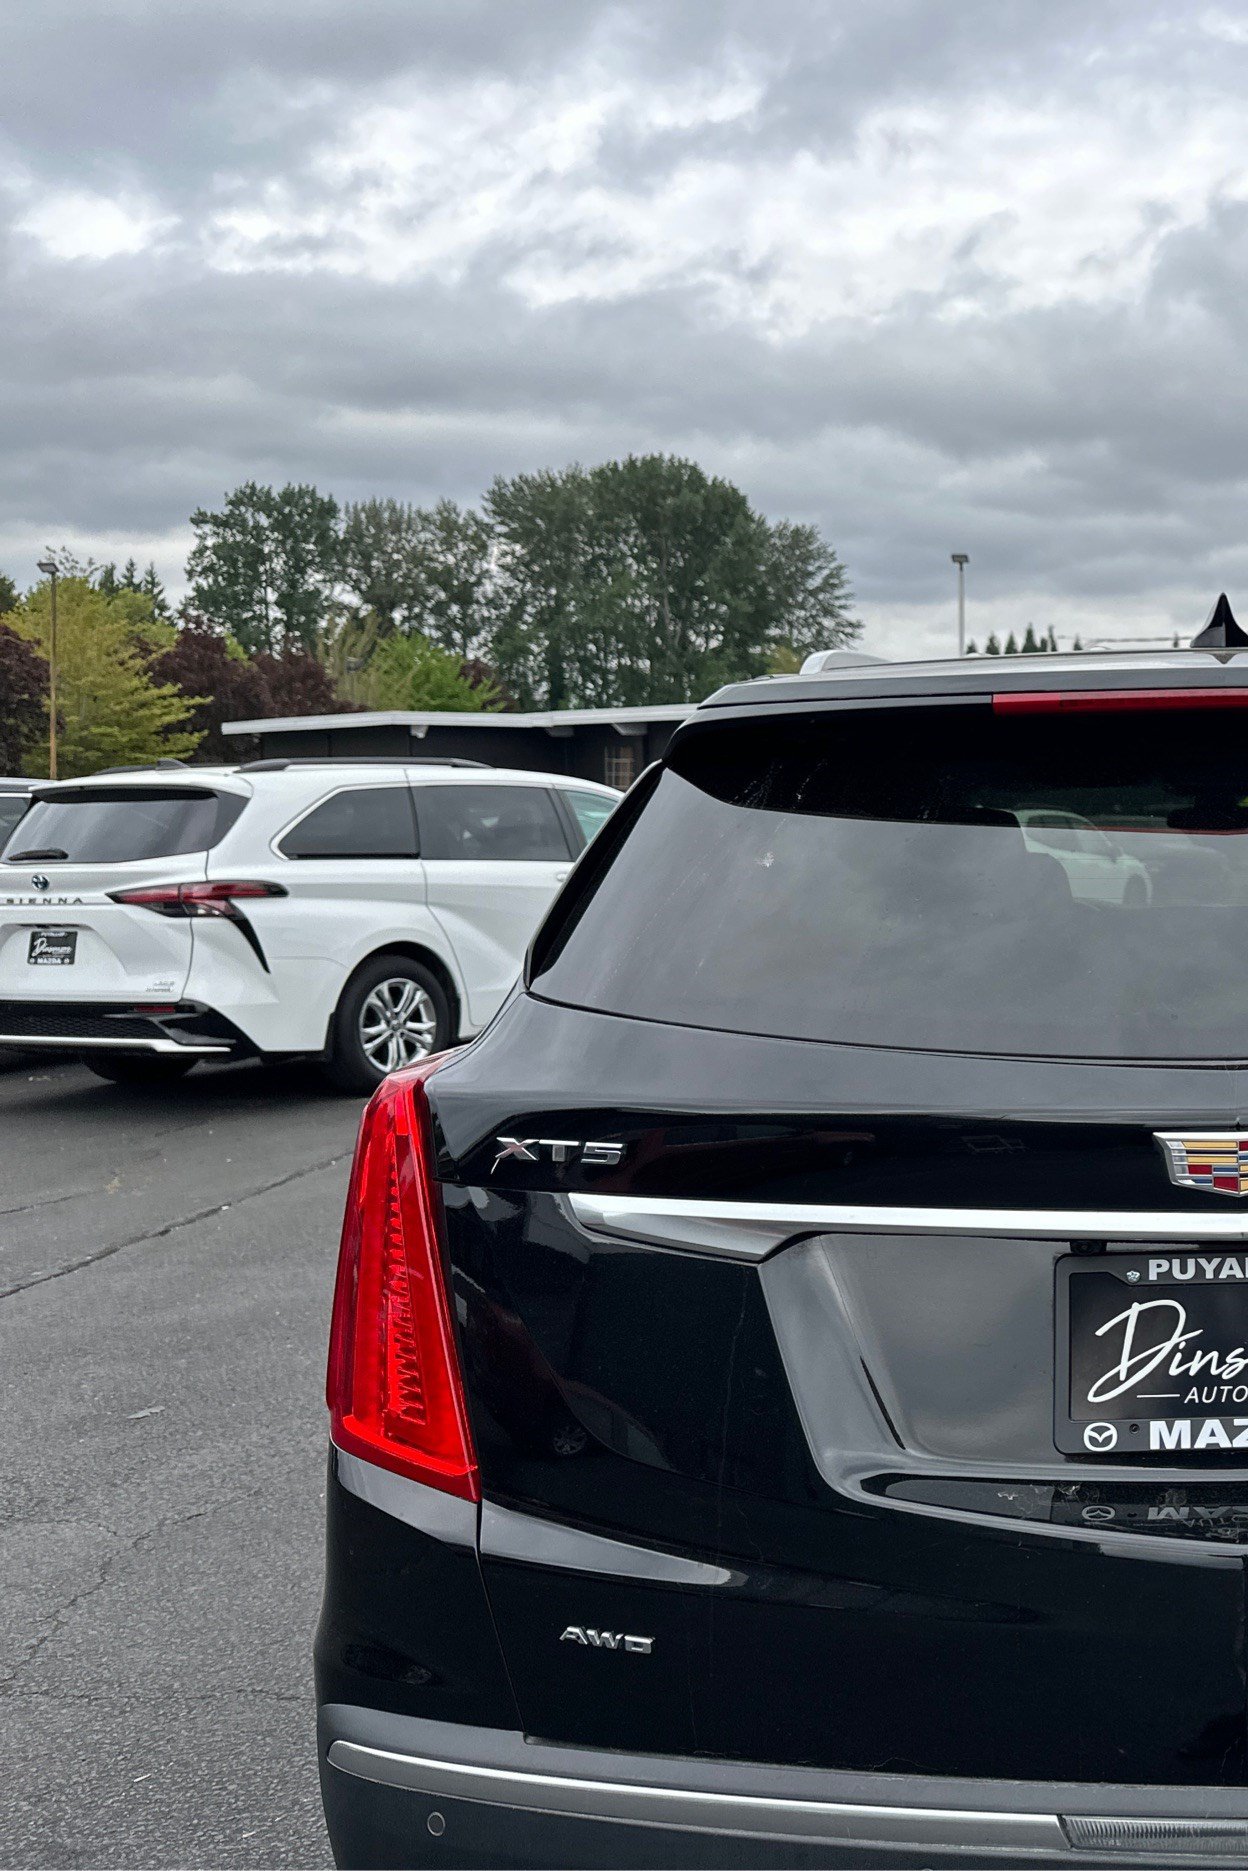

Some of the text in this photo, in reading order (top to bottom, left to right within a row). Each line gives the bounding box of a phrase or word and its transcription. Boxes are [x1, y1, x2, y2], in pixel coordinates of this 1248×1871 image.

[6, 897, 83, 905] SIENNA
[489, 1137, 624, 1175] XT5
[559, 1626, 656, 1654] AWD
